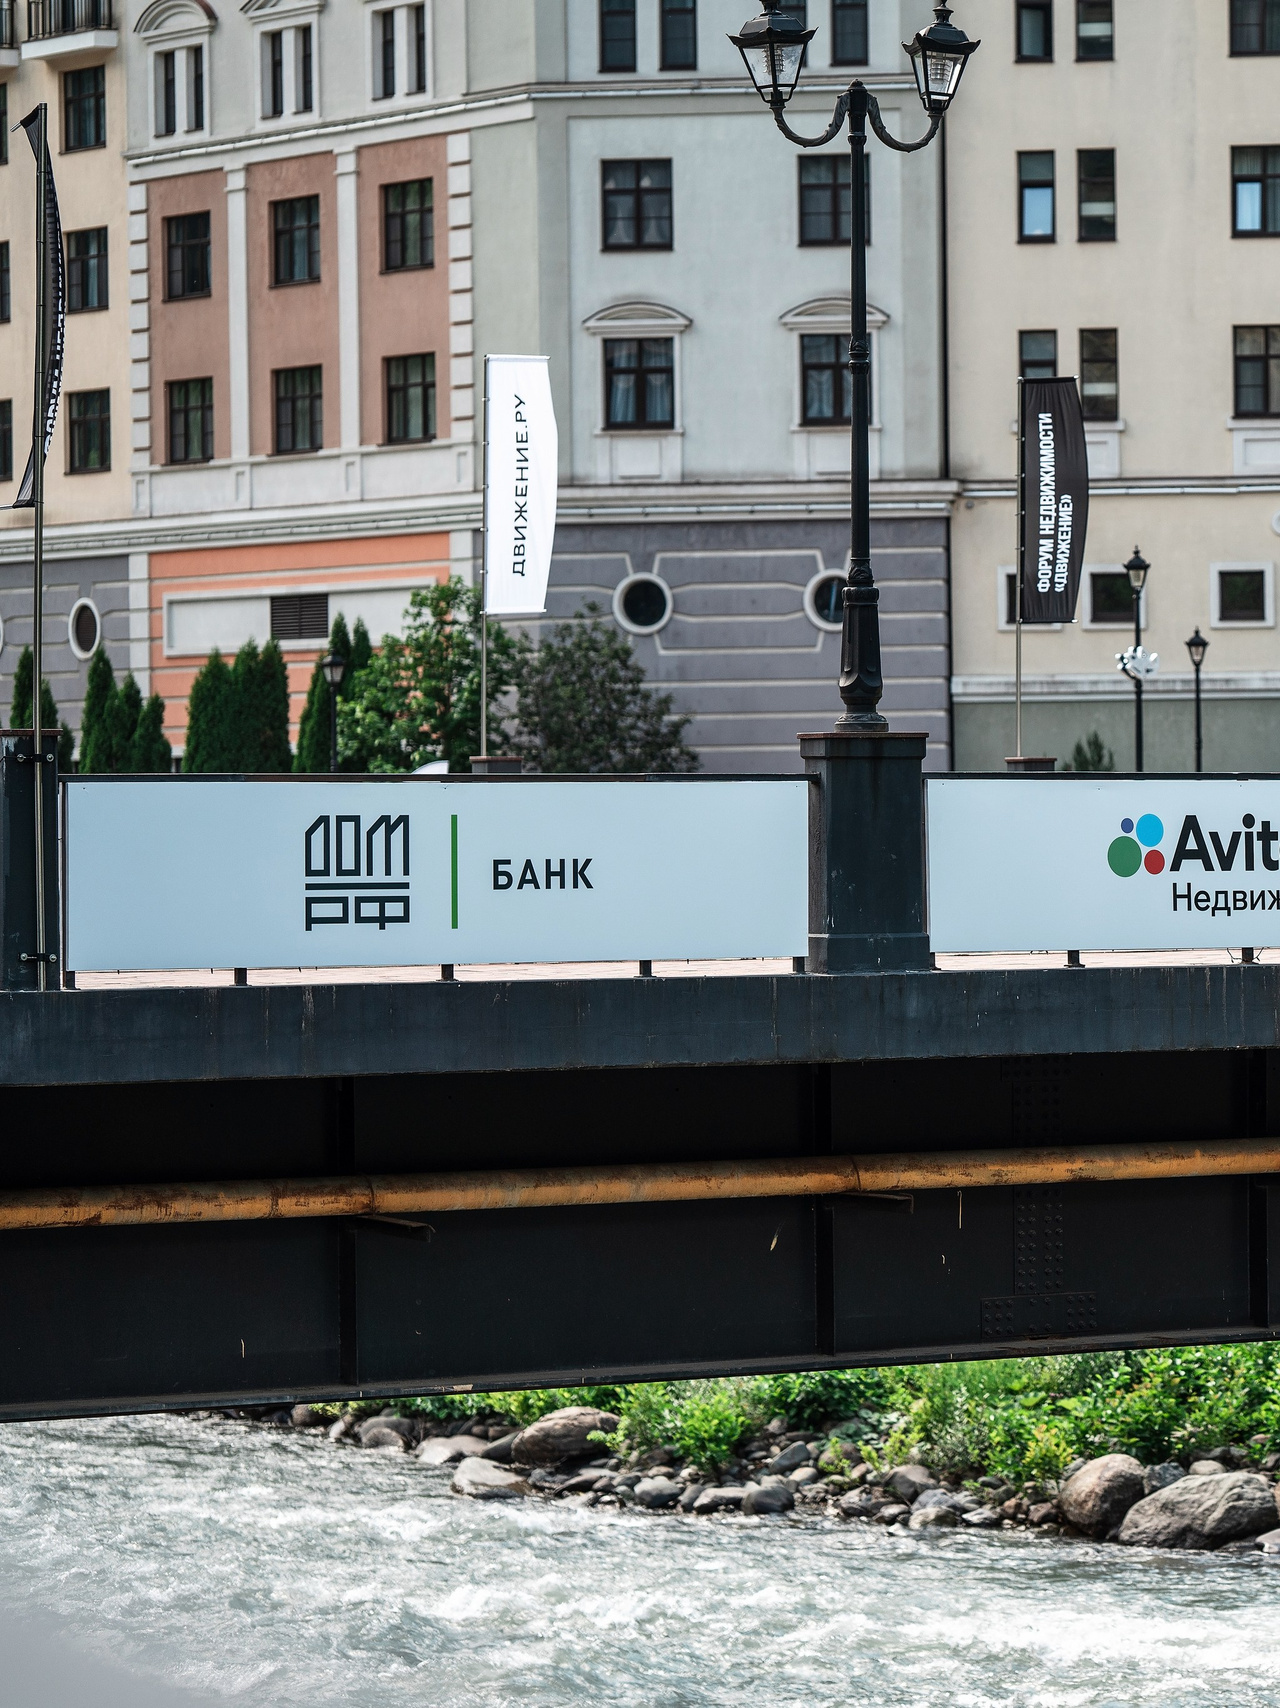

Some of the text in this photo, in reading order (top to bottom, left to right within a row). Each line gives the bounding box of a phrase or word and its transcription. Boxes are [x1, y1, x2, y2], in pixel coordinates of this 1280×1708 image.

[512, 394, 529, 577] ДВИЖЕНИЕ.РУ
[1037, 412, 1057, 593] ФОРУМ НЕДВИЖИМОСТИ
[1054, 494, 1073, 593] «ДВИЖЕНИЕ»
[305, 895, 410, 931] РФ
[492, 858, 594, 890] БАНК
